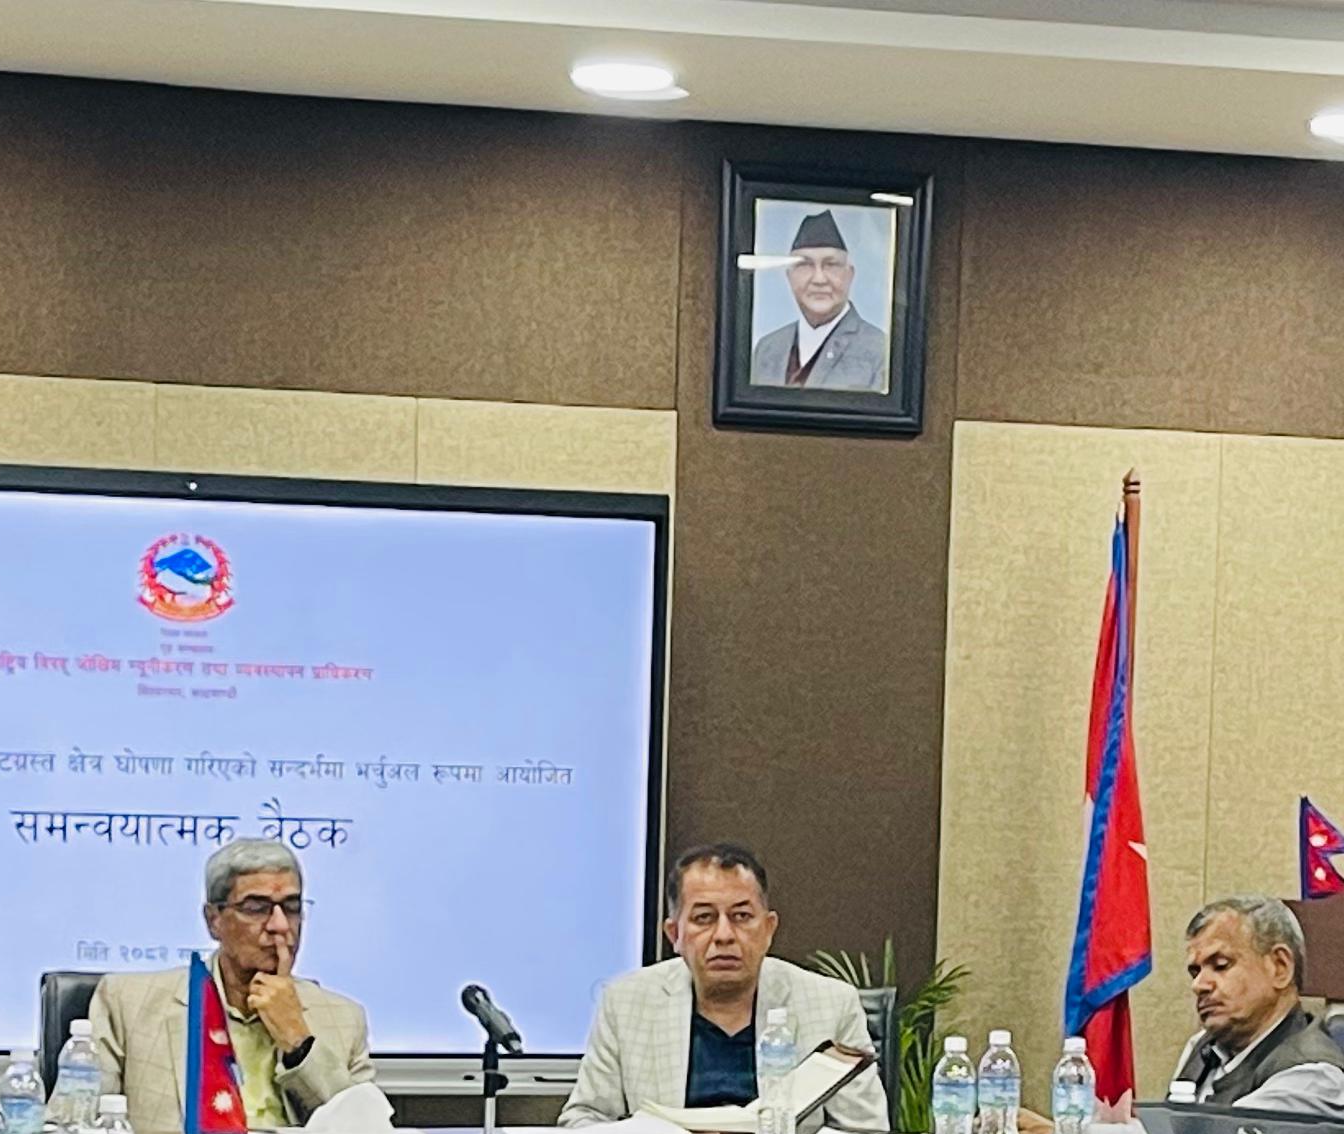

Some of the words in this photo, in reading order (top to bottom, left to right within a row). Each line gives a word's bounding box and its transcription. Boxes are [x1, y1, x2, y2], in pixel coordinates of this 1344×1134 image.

[68, 746, 104, 774] क्षेत्र
[114, 748, 174, 775] घोषणा
[184, 751, 256, 781] गरिएको
[269, 754, 344, 780] सन्दर्भमा
[432, 764, 484, 785] रूपमा
[496, 758, 573, 785] आयोजित
[9, 809, 240, 847] समन्वयात्मक
[120, 945, 169, 963] २०८२
